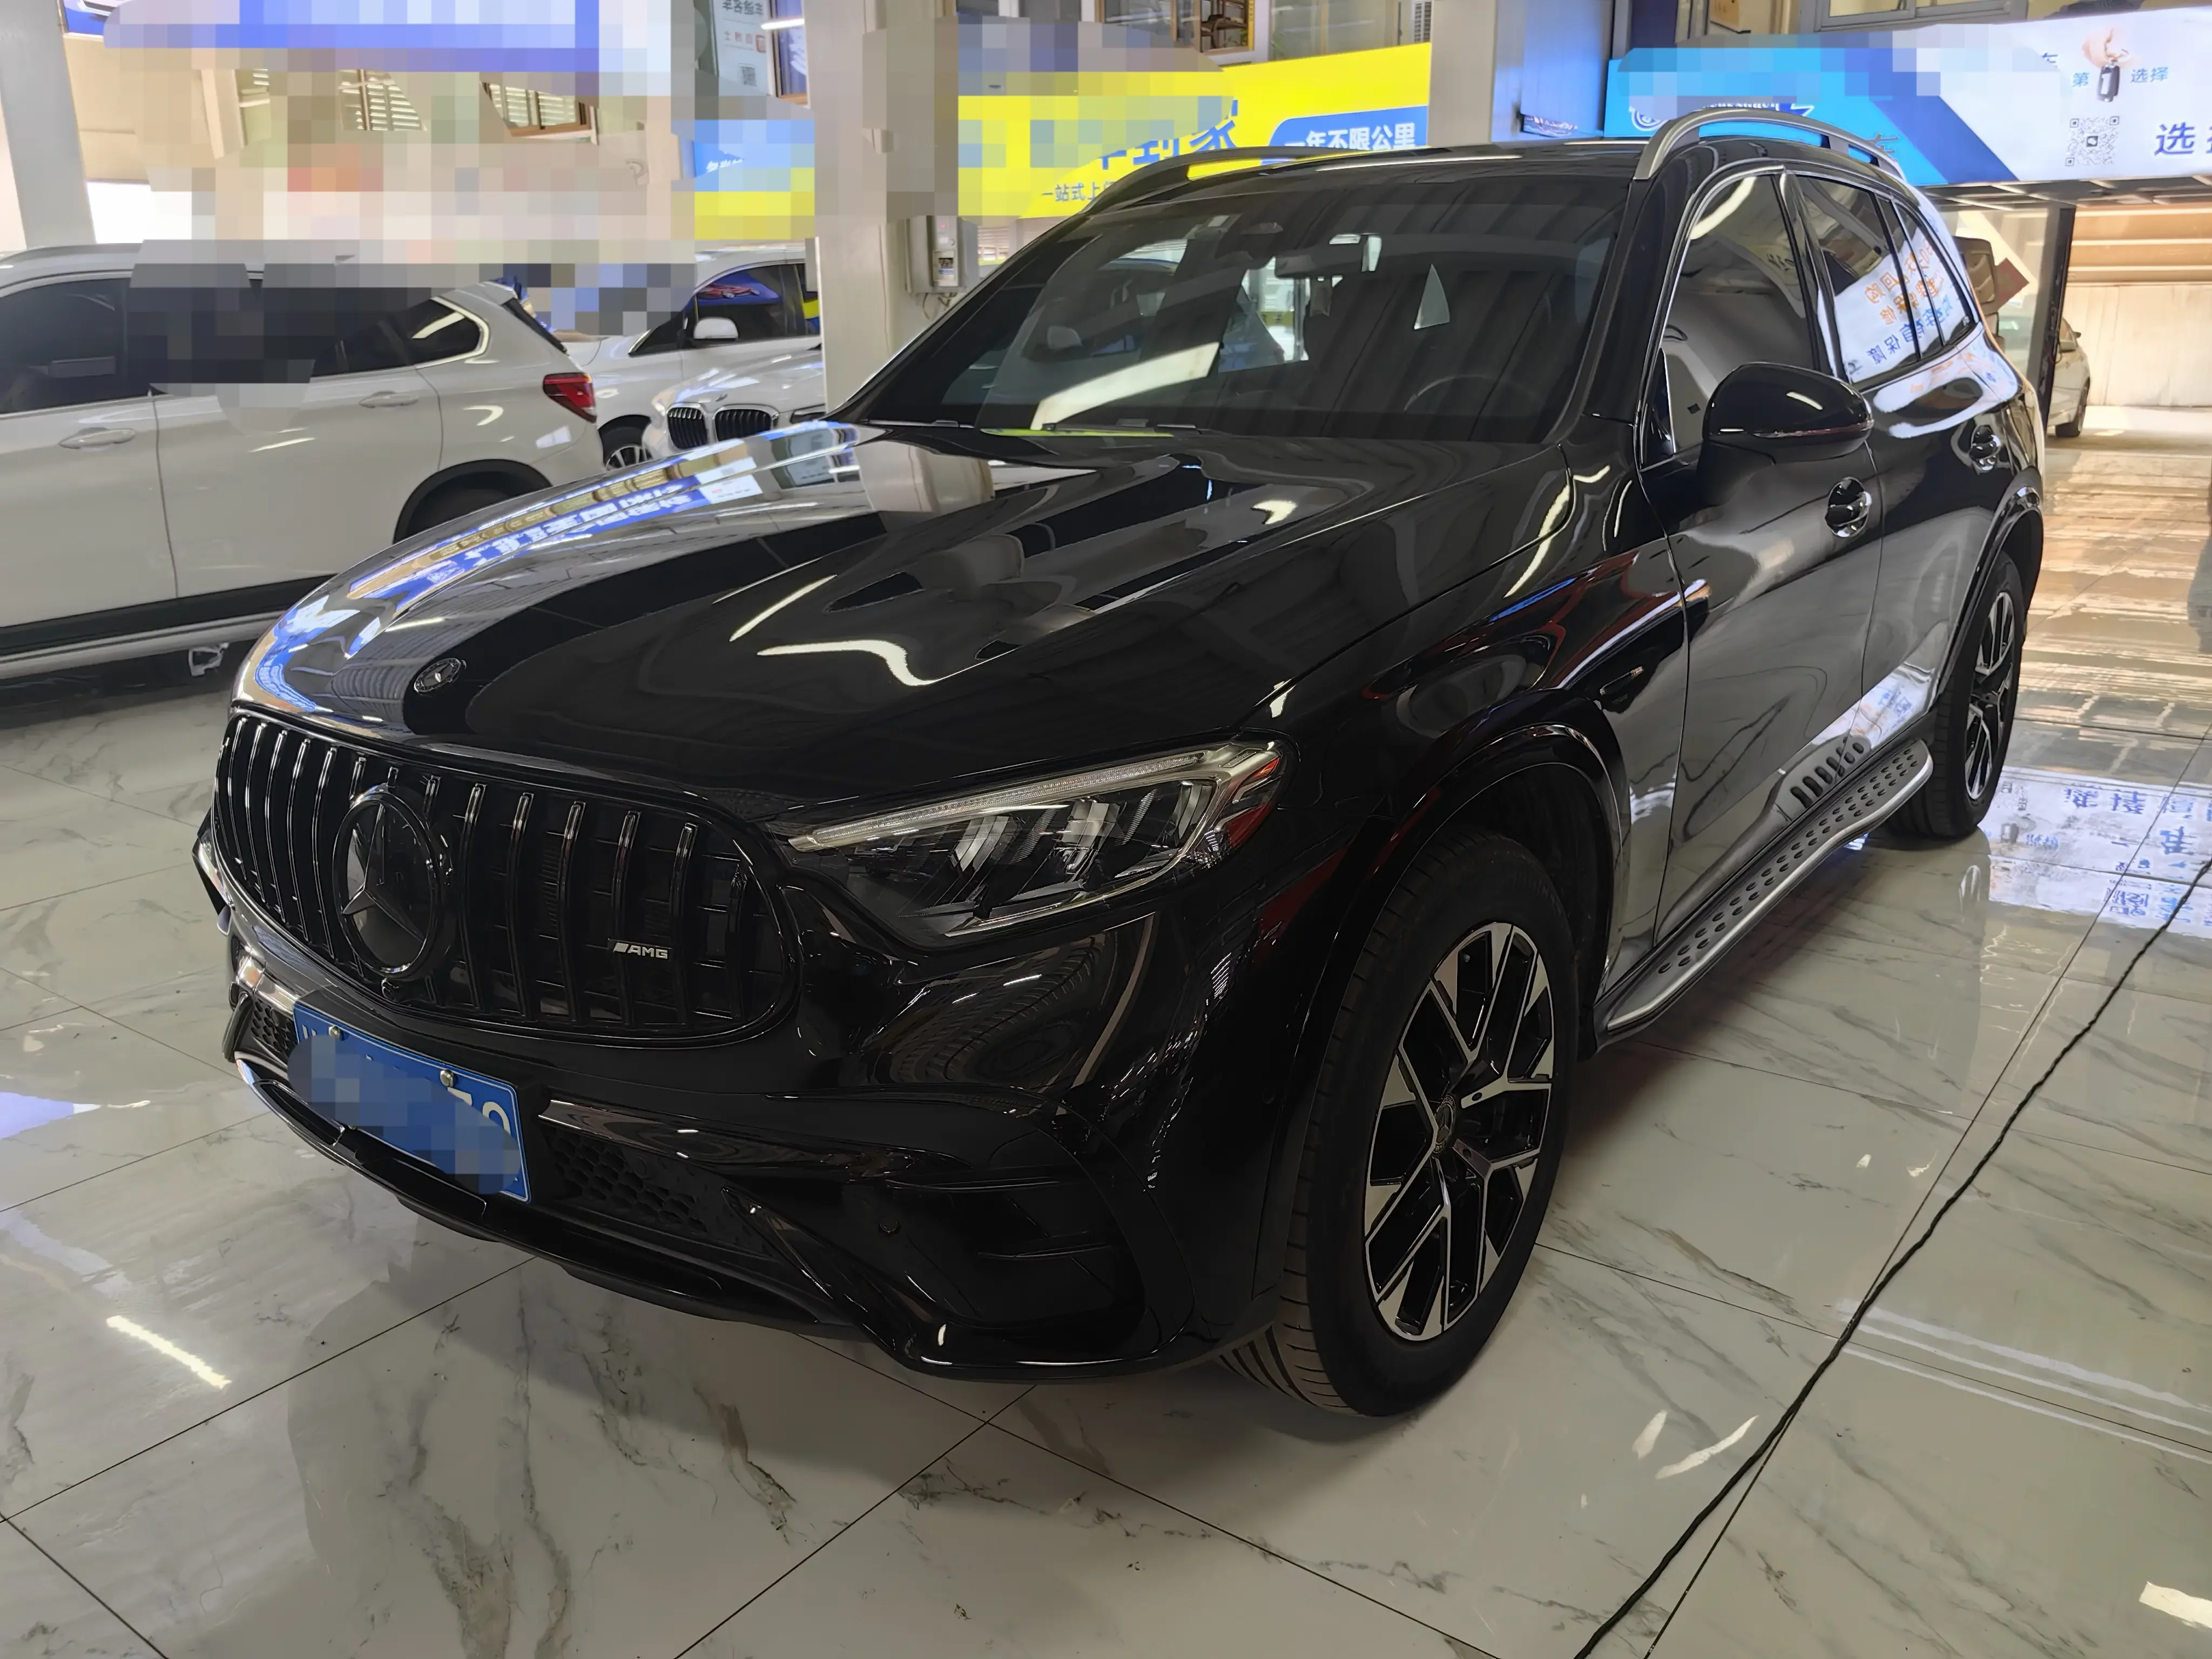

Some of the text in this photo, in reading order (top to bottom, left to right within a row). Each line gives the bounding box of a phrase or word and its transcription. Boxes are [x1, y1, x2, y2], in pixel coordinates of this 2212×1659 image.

[2072, 72, 2089, 87] 第
[2130, 67, 2168, 83] 选择
[2154, 122, 2212, 157] 选
[1041, 181, 1115, 202] 一站式上
[628, 945, 668, 959] AMG
